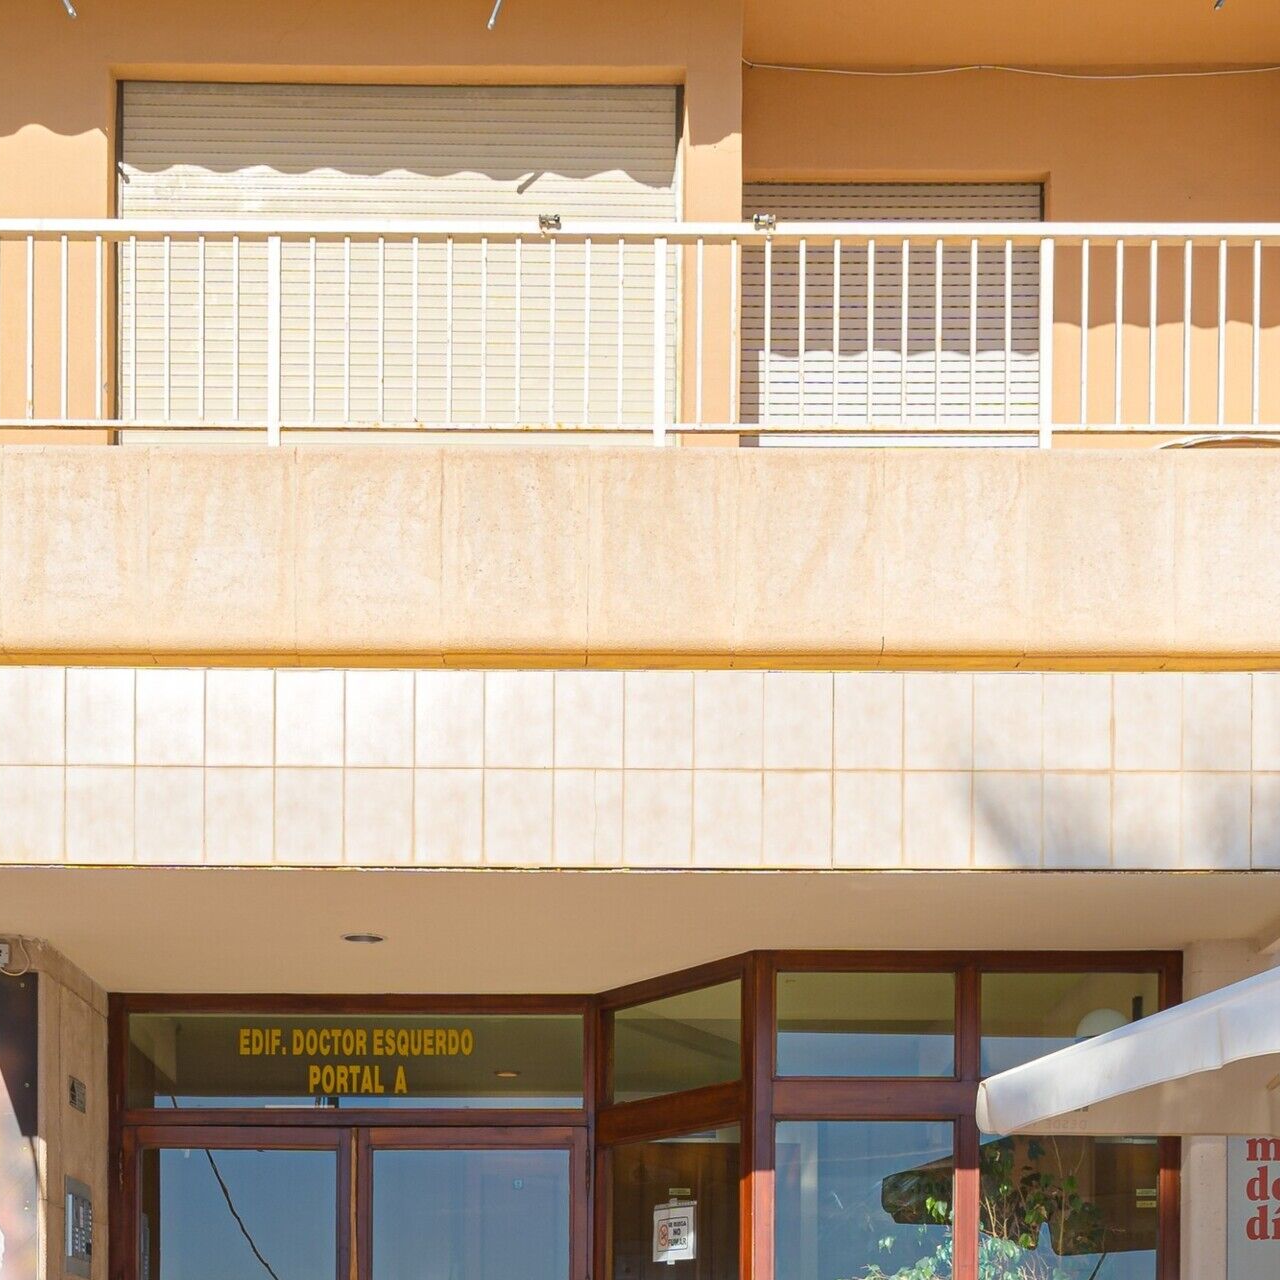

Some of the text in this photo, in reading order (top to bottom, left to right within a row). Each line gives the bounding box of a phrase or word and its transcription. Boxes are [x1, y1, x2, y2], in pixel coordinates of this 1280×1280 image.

[239, 1028, 474, 1057] EDIF. DOCTOR ESQUERDO
[308, 1064, 408, 1094] PORTAL A
